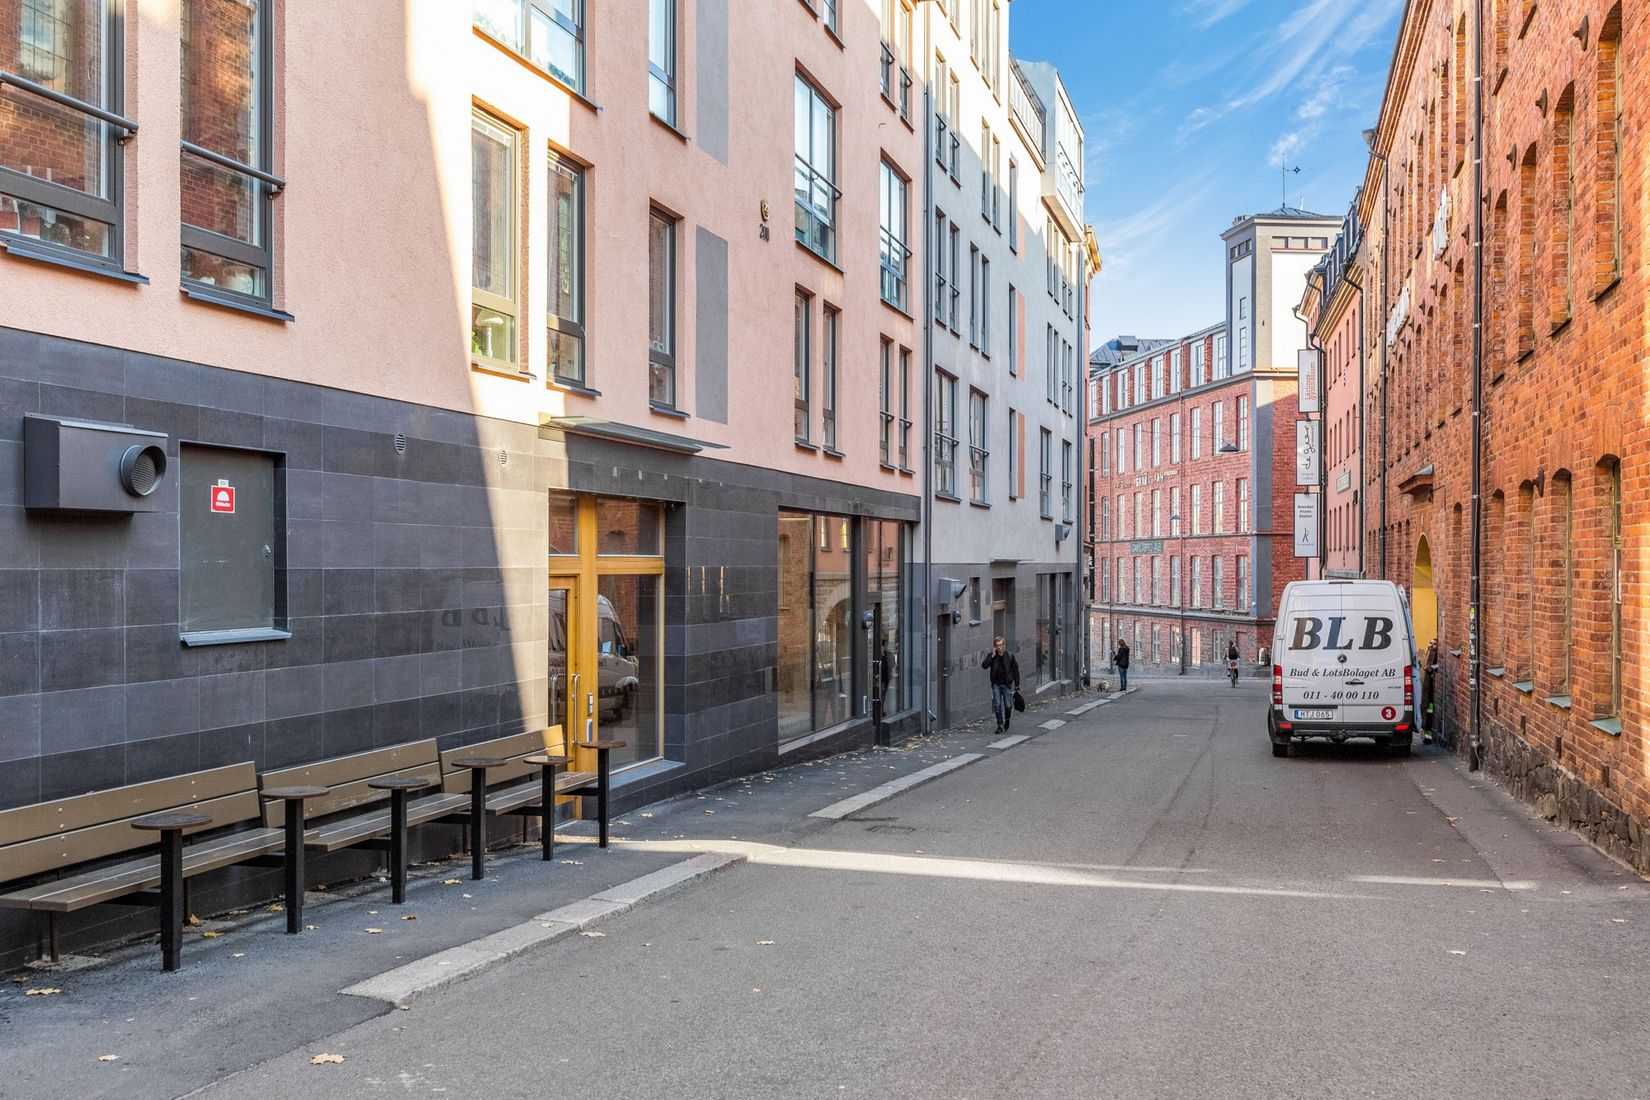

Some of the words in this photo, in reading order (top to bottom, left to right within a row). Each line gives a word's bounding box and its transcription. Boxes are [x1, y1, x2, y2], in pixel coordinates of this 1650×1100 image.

[1288, 616, 1394, 651] BLB
[1290, 668, 1310, 677] Bud
[1311, 669, 1320, 677] &
[1322, 668, 1379, 679] LotsBolaget
[1381, 669, 1396, 677] AB
[1303, 691, 1320, 700] 011
[1330, 691, 1343, 700] 40
[1345, 691, 1358, 700] 00
[1361, 691, 1379, 700] 110
[1385, 709, 1392, 719] 3
